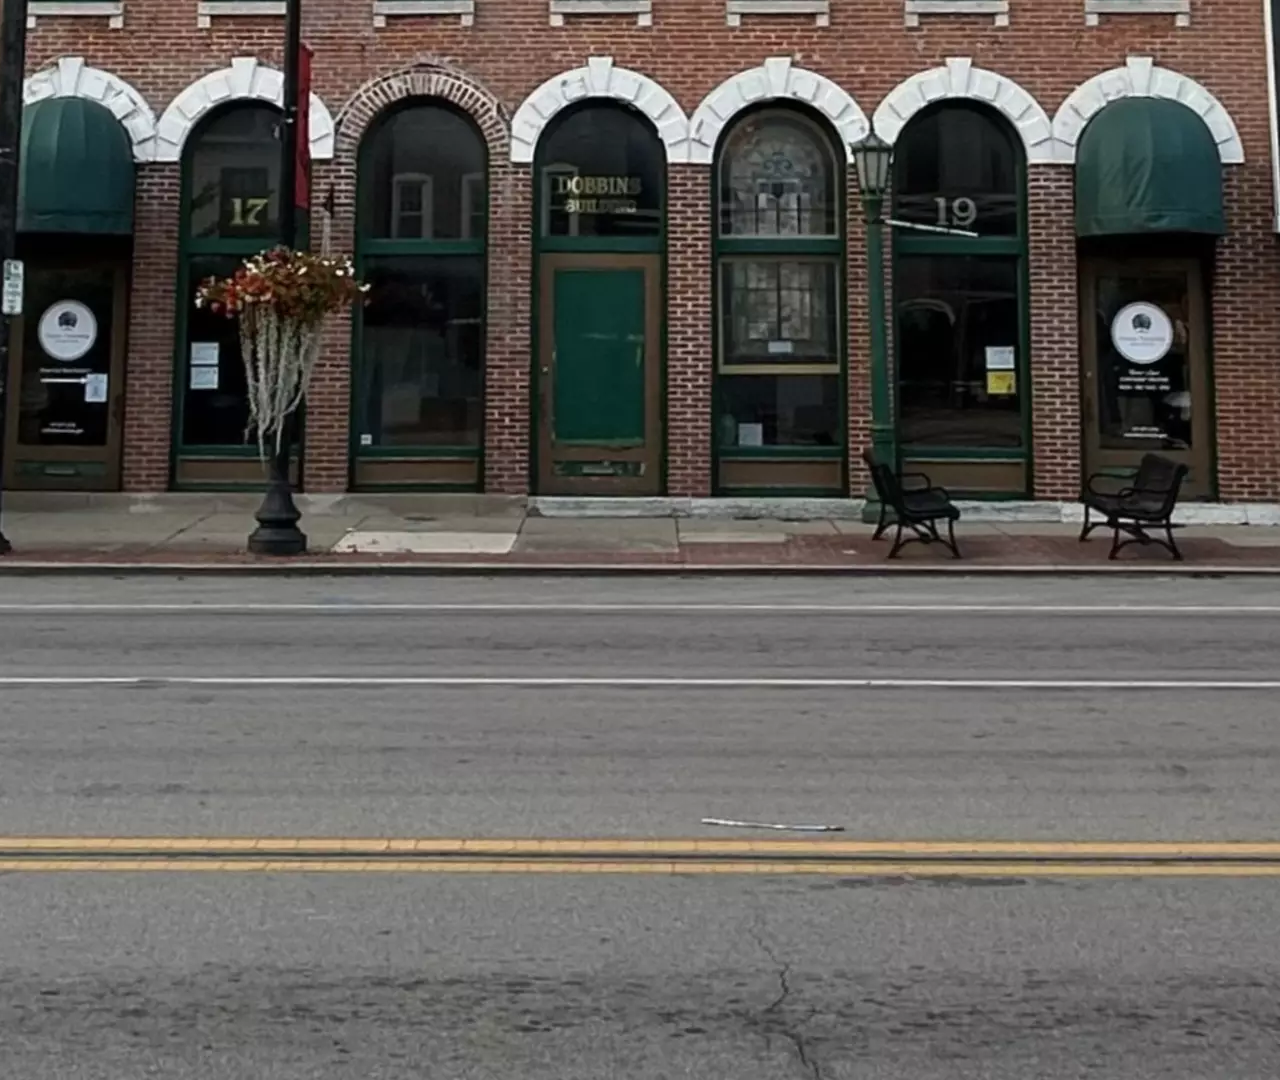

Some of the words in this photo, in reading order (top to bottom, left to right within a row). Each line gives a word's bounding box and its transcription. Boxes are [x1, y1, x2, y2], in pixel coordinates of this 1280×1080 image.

[557, 175, 643, 195] DOBBINS
[230, 197, 269, 227] 17
[933, 196, 978, 226] 19
